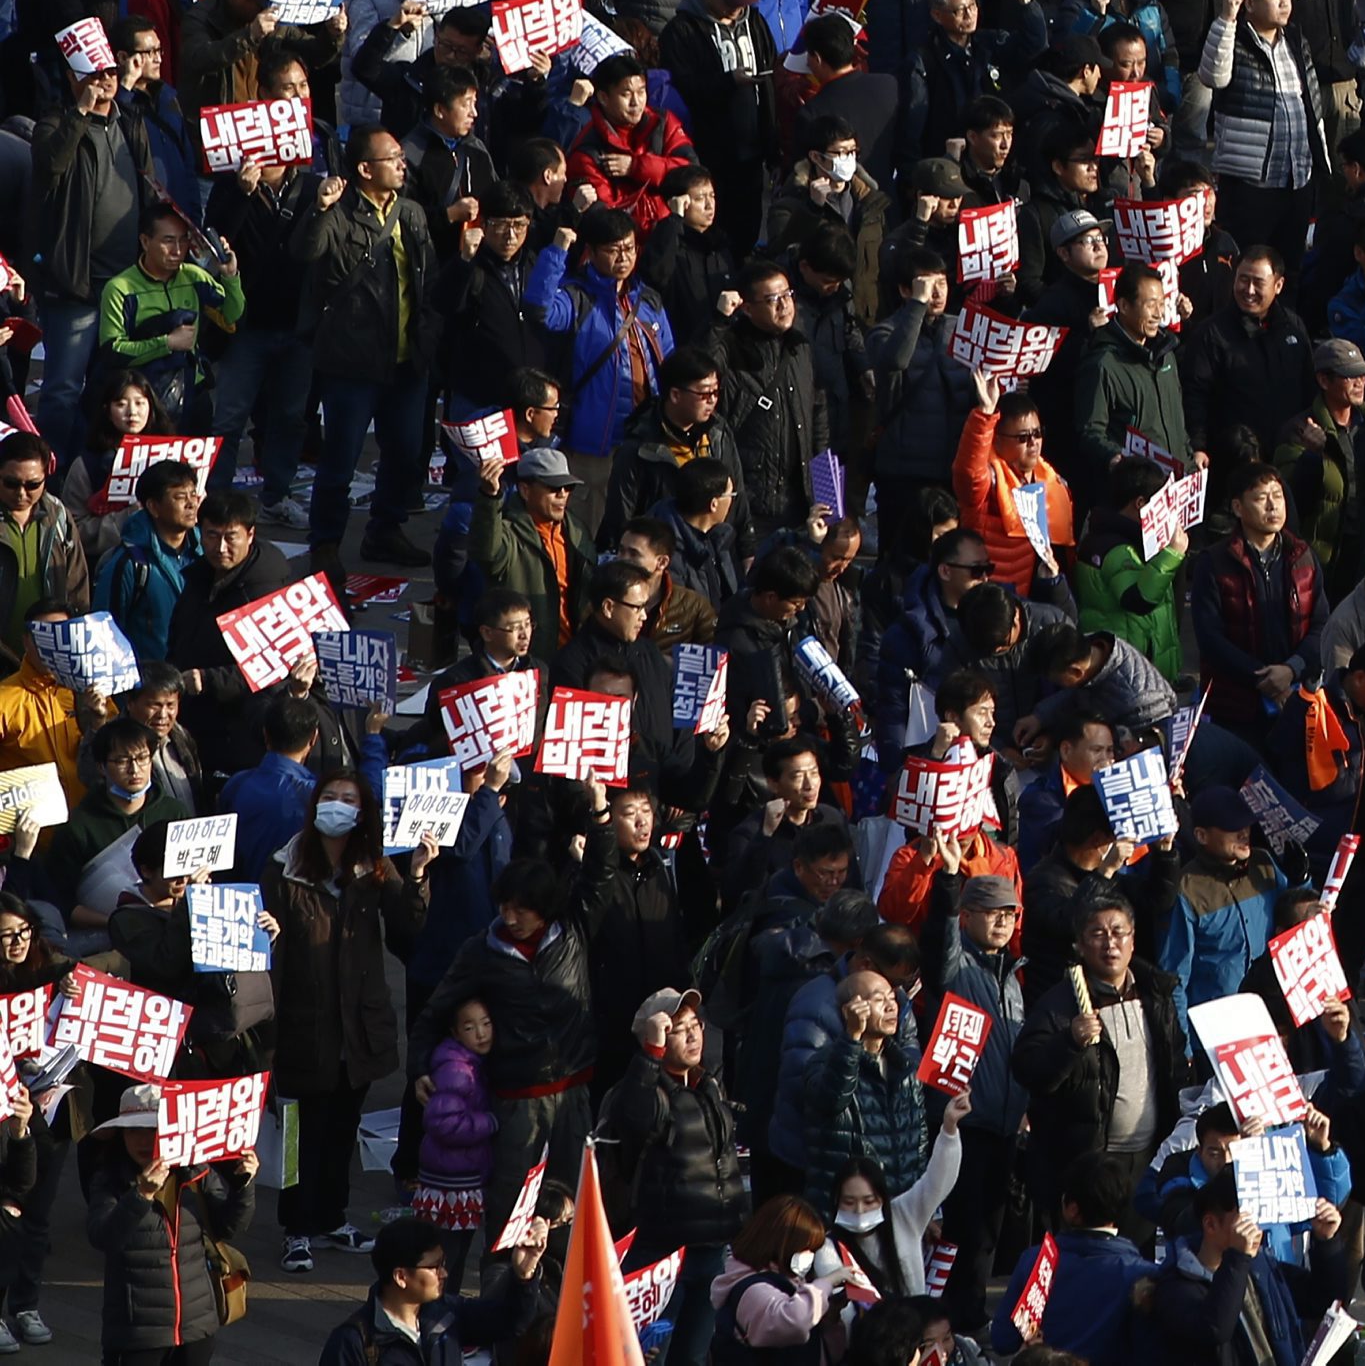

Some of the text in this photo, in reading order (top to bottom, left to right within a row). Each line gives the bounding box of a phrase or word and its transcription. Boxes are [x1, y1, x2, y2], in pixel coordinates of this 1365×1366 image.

[202, 100, 307, 145] 내려와
[1114, 196, 1204, 240] 내려와
[956, 306, 1059, 353] 내려와
[953, 336, 1051, 374] 박근혜
[33, 614, 111, 648] 끝내자
[222, 573, 328, 658] 내려와
[316, 634, 389, 663] 끝내자
[441, 670, 537, 723] 내려와
[900, 760, 992, 801] 내려와
[407, 793, 465, 816] 하야하라
[168, 821, 234, 845] 하야하라
[177, 846, 221, 869] 박근혜
[190, 886, 257, 924] 끝내자
[190, 915, 254, 948] 노동개악
[66, 982, 184, 1042] 내려와
[160, 1073, 265, 1135] 내려와
[158, 1119, 260, 1166] 박근혜
